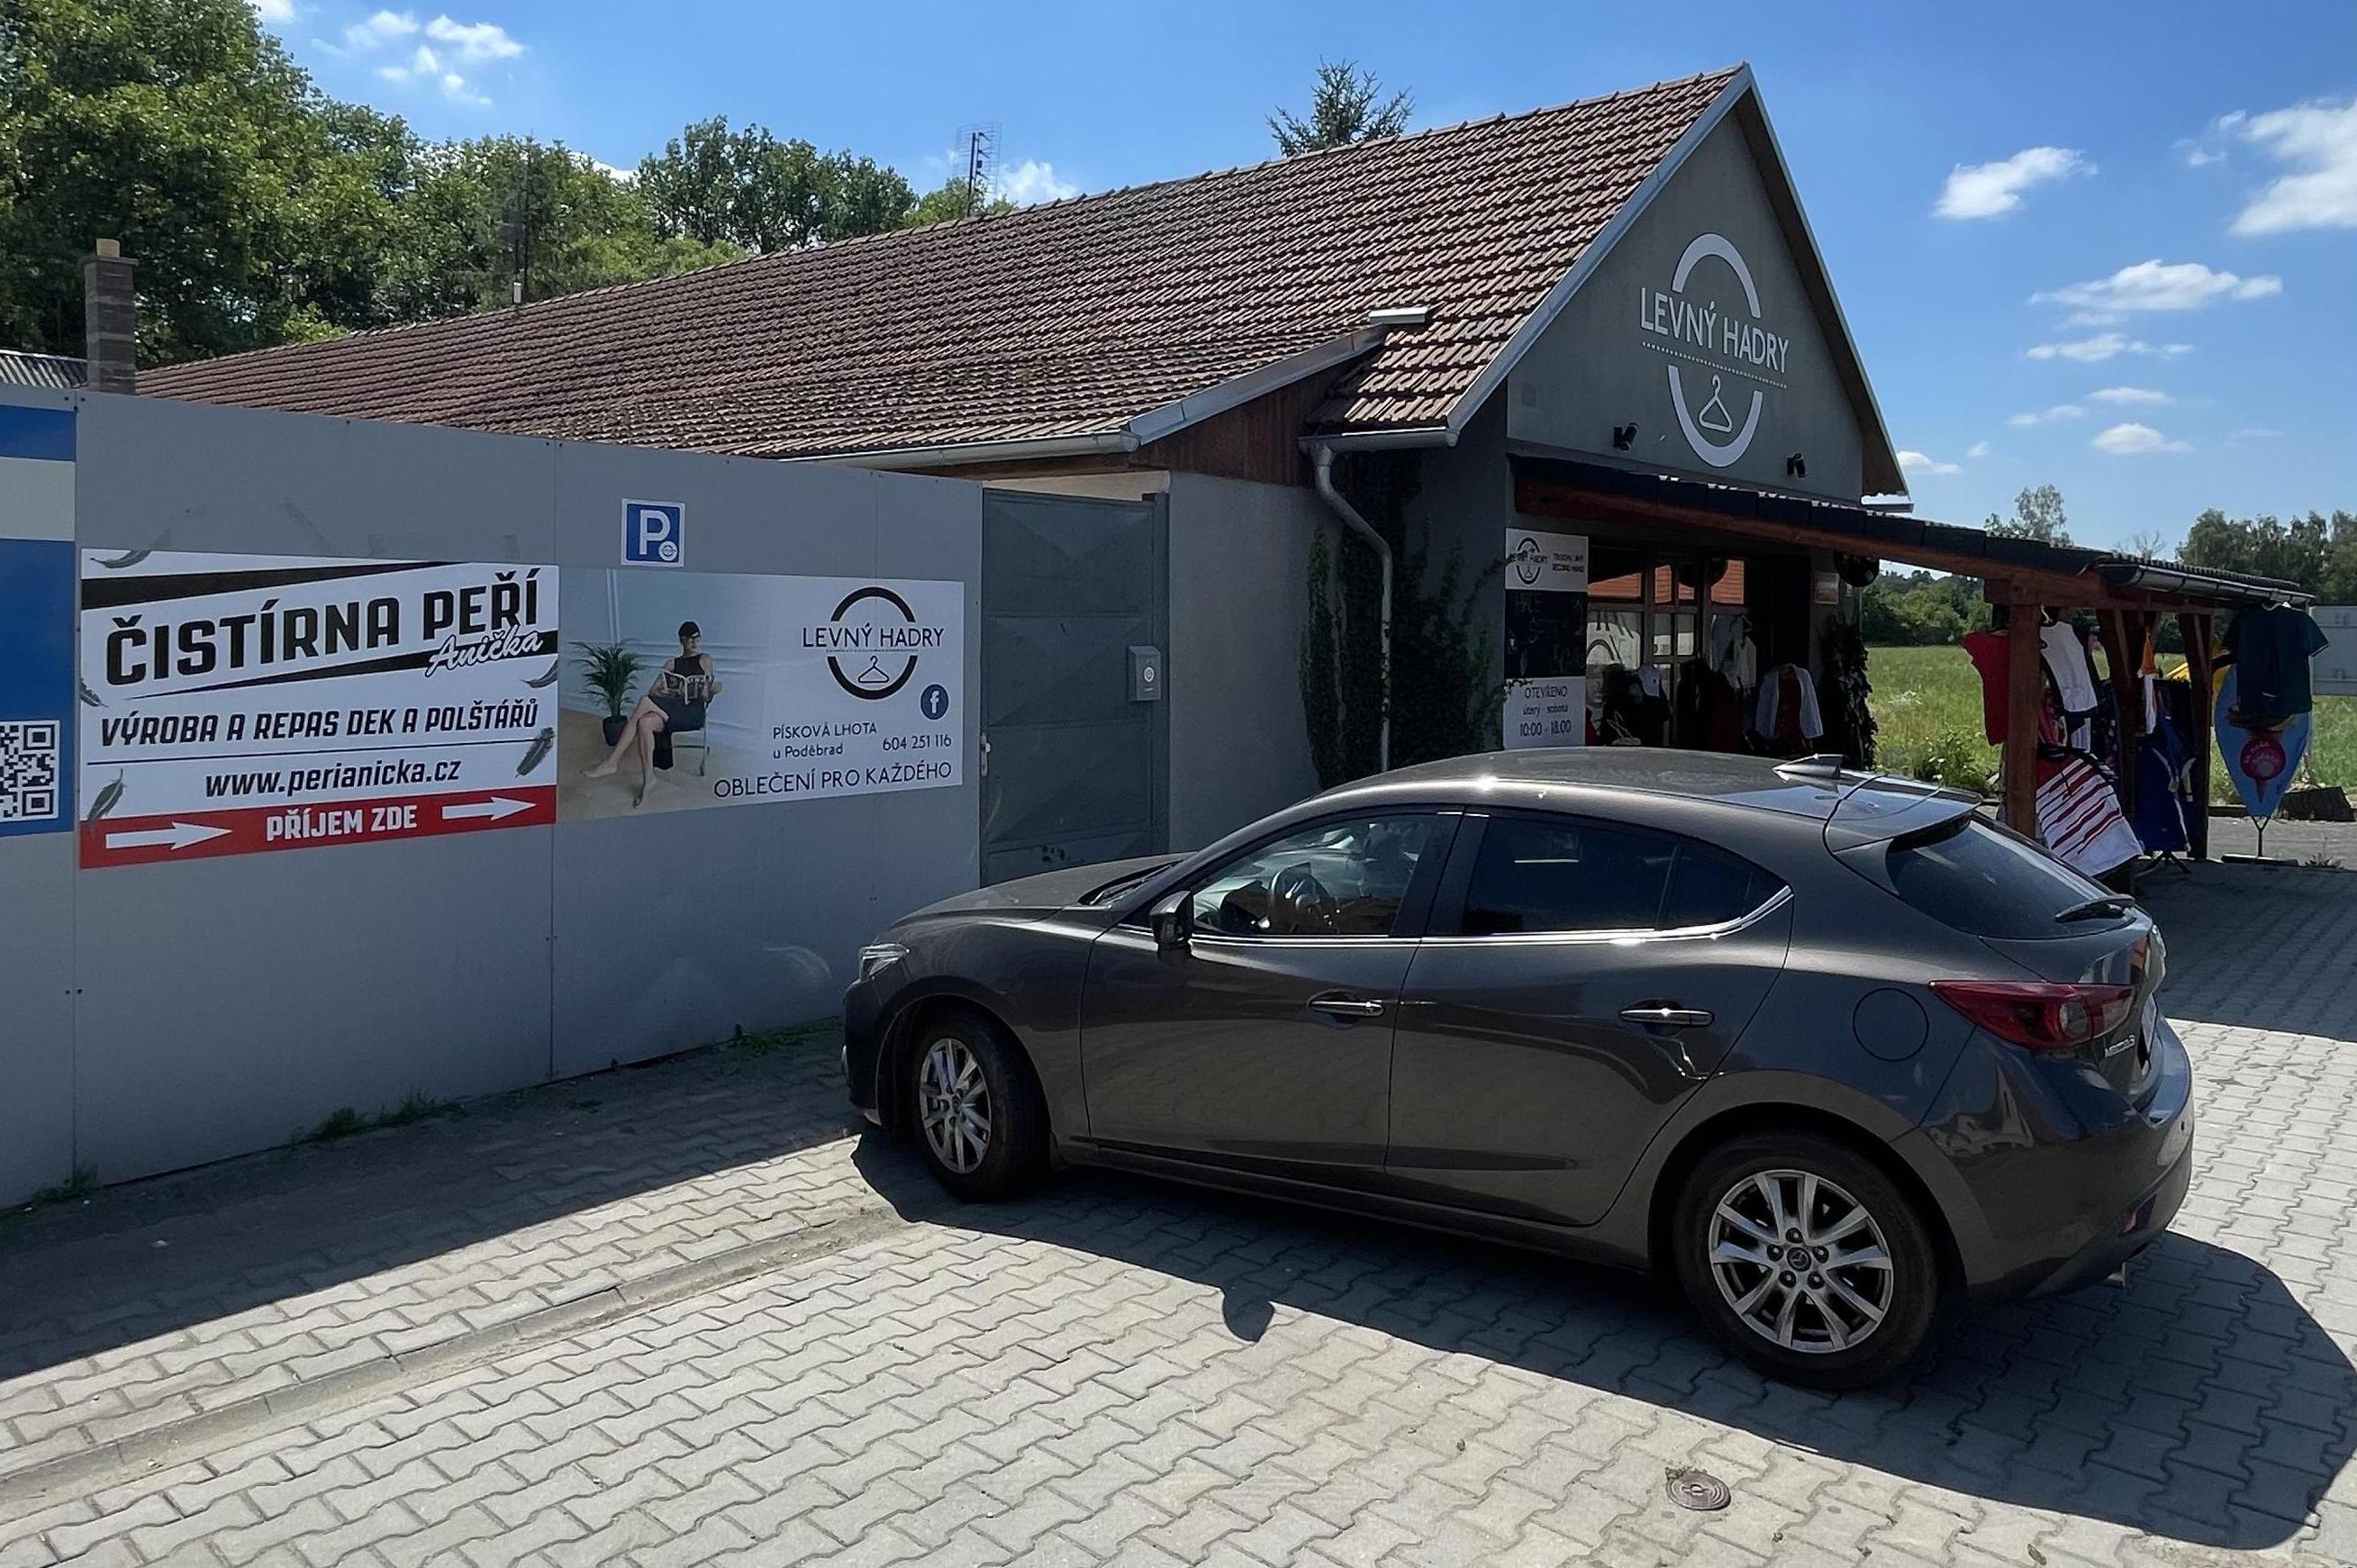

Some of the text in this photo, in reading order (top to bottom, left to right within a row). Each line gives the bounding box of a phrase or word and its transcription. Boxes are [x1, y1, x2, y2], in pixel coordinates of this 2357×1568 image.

[1640, 286, 1790, 374] LEVNÝ HADRY
[639, 509, 670, 555] P
[106, 567, 541, 685] ČISTÍRNA PEŘÍ
[802, 622, 945, 648] LEVNÝ HADRY
[425, 624, 543, 677] Anička
[101, 698, 539, 747] VÝROBA A REPAS DEK A POLŠTÁŘŮ
[773, 721, 877, 739] PÍSKOVÁ LHOTA
[883, 733, 953, 751] 604 251 116
[773, 743, 844, 758] u Poděbrad
[205, 758, 461, 798] www.perianicka.cz
[713, 759, 953, 798] OBLEČENÍ PRO KAŽDÉHO
[266, 804, 418, 841] PŘÍJEM ZDE
